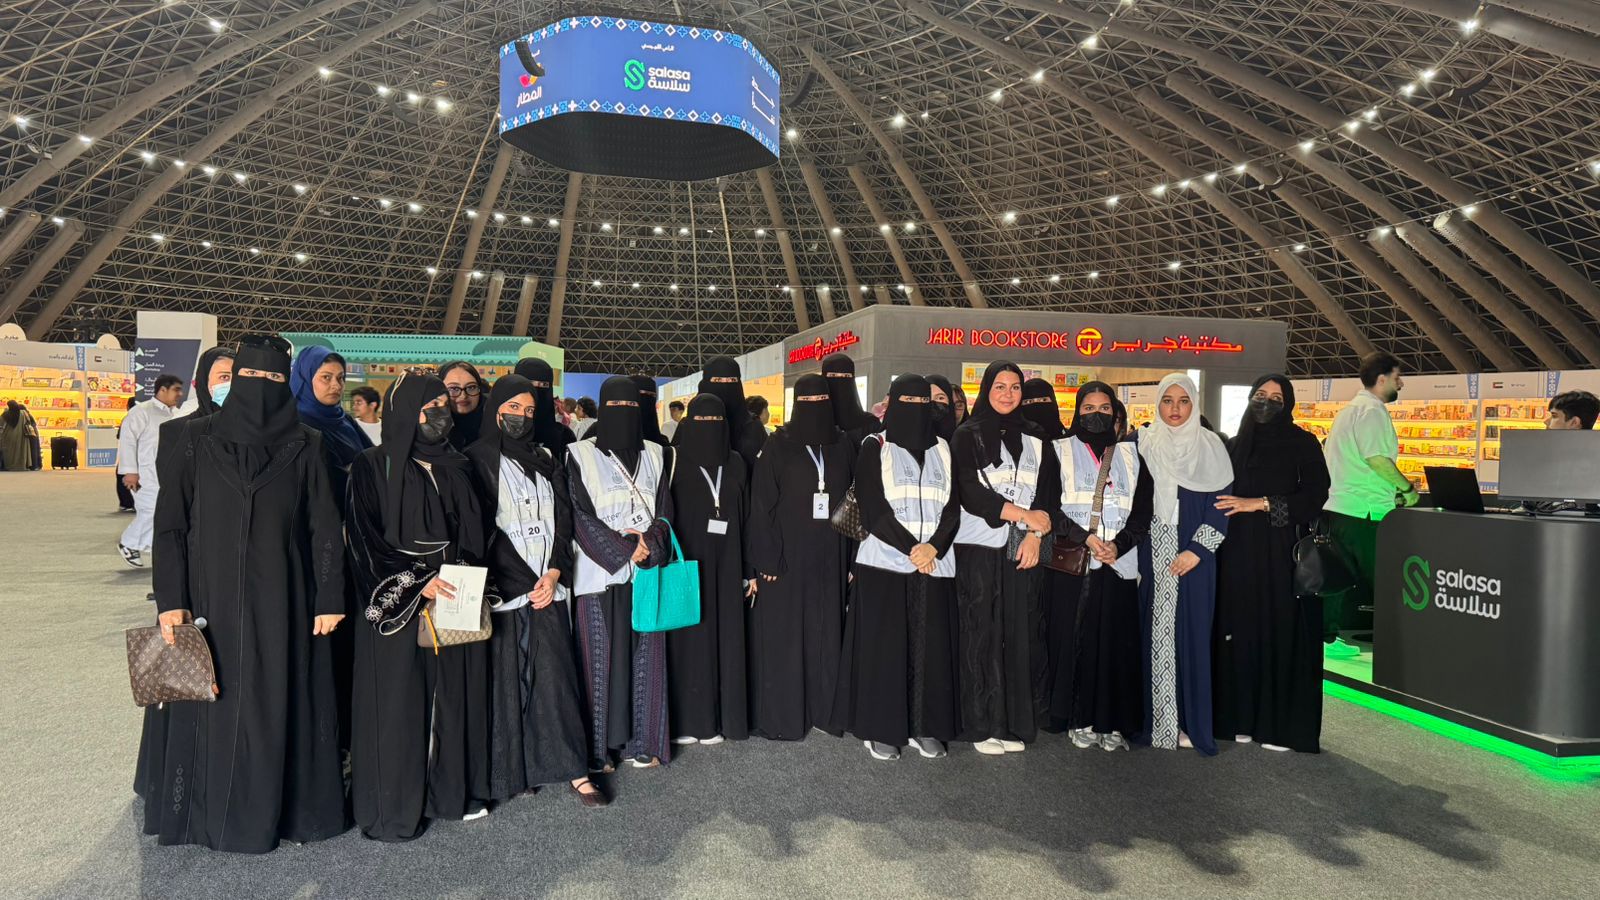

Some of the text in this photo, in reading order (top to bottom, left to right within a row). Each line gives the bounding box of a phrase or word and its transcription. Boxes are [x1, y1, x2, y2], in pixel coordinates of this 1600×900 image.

[648, 66, 691, 81] salasa
[647, 76, 691, 92] سلاسة
[516, 86, 542, 108] المطار
[927, 328, 1068, 350] JARIR BOOKSTORE
[1109, 335, 1245, 355] مكتبة جرير
[1003, 487, 1015, 497] 16
[818, 503, 824, 511] 2
[631, 514, 643, 525] 15
[528, 526, 541, 535] 20
[1435, 568, 1502, 597] salasa
[1434, 586, 1501, 620] سلاسة
